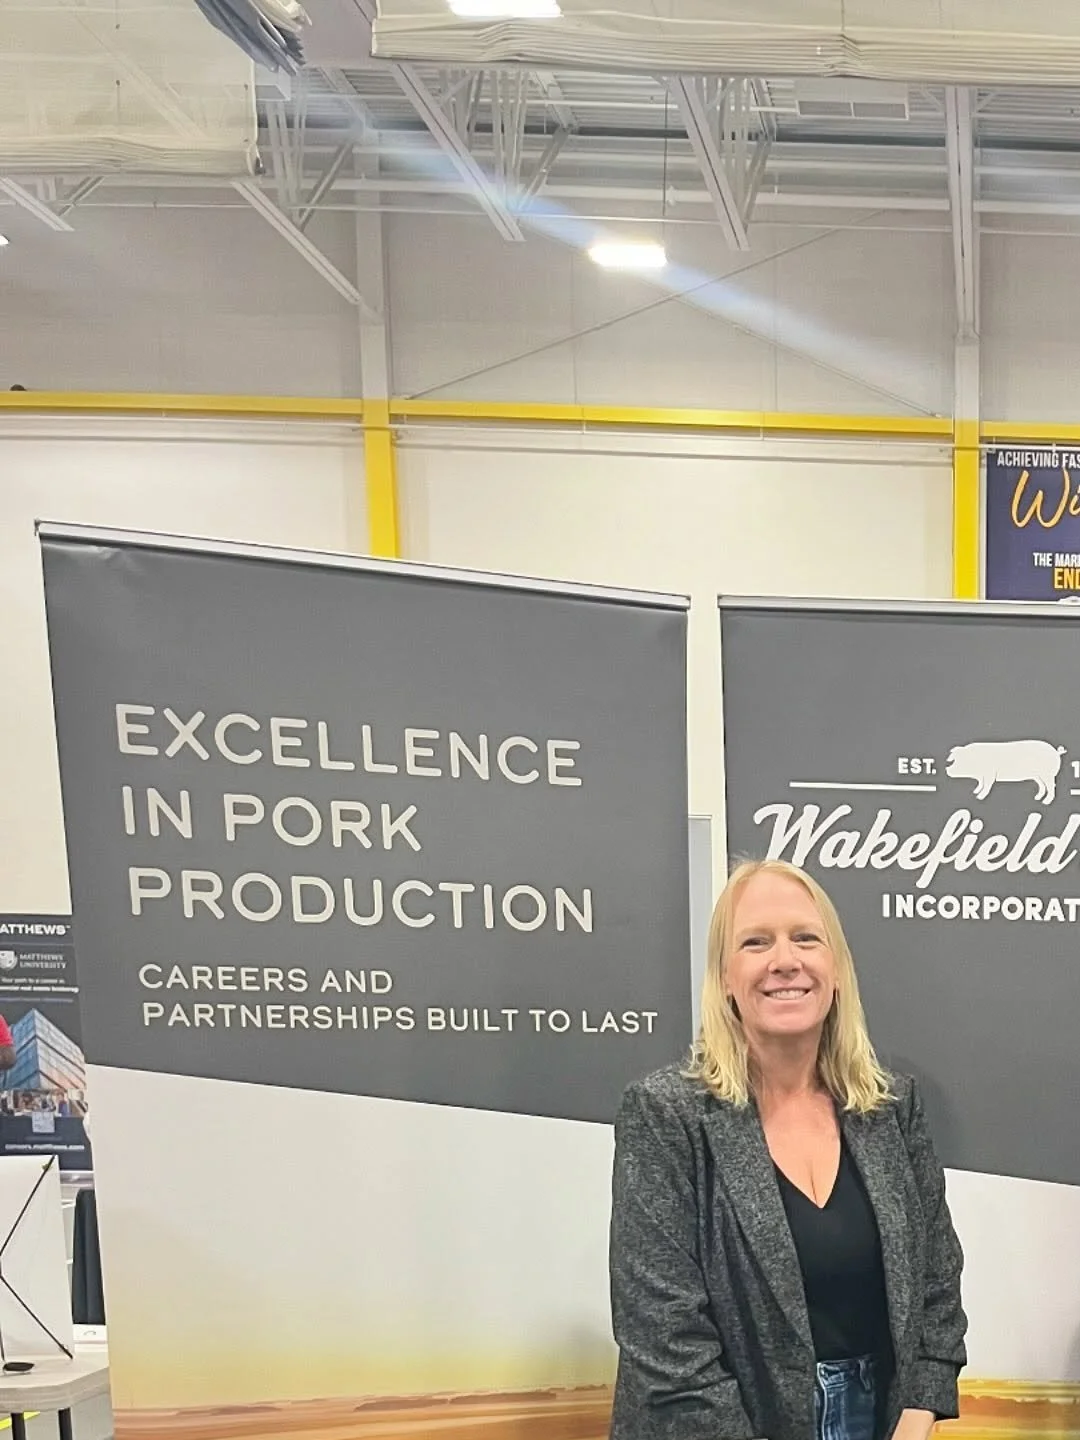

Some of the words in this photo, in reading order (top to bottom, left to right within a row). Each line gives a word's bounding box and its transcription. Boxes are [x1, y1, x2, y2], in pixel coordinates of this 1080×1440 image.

[997, 451, 1059, 467] ACHIEVING
[1033, 552, 1052, 567] THE
[115, 703, 582, 787] EXCELLENCE
[898, 757, 937, 776] EST.
[122, 785, 193, 839] IN
[222, 793, 422, 852] PORK
[128, 866, 594, 933] PRODUCTION
[138, 963, 309, 993] CAREERS
[320, 969, 394, 995] AND
[143, 1002, 416, 1030] PARTNERSHIPS
[427, 1008, 519, 1032] BUILT
[529, 1009, 571, 1033] TO
[582, 1011, 659, 1034] LAST
